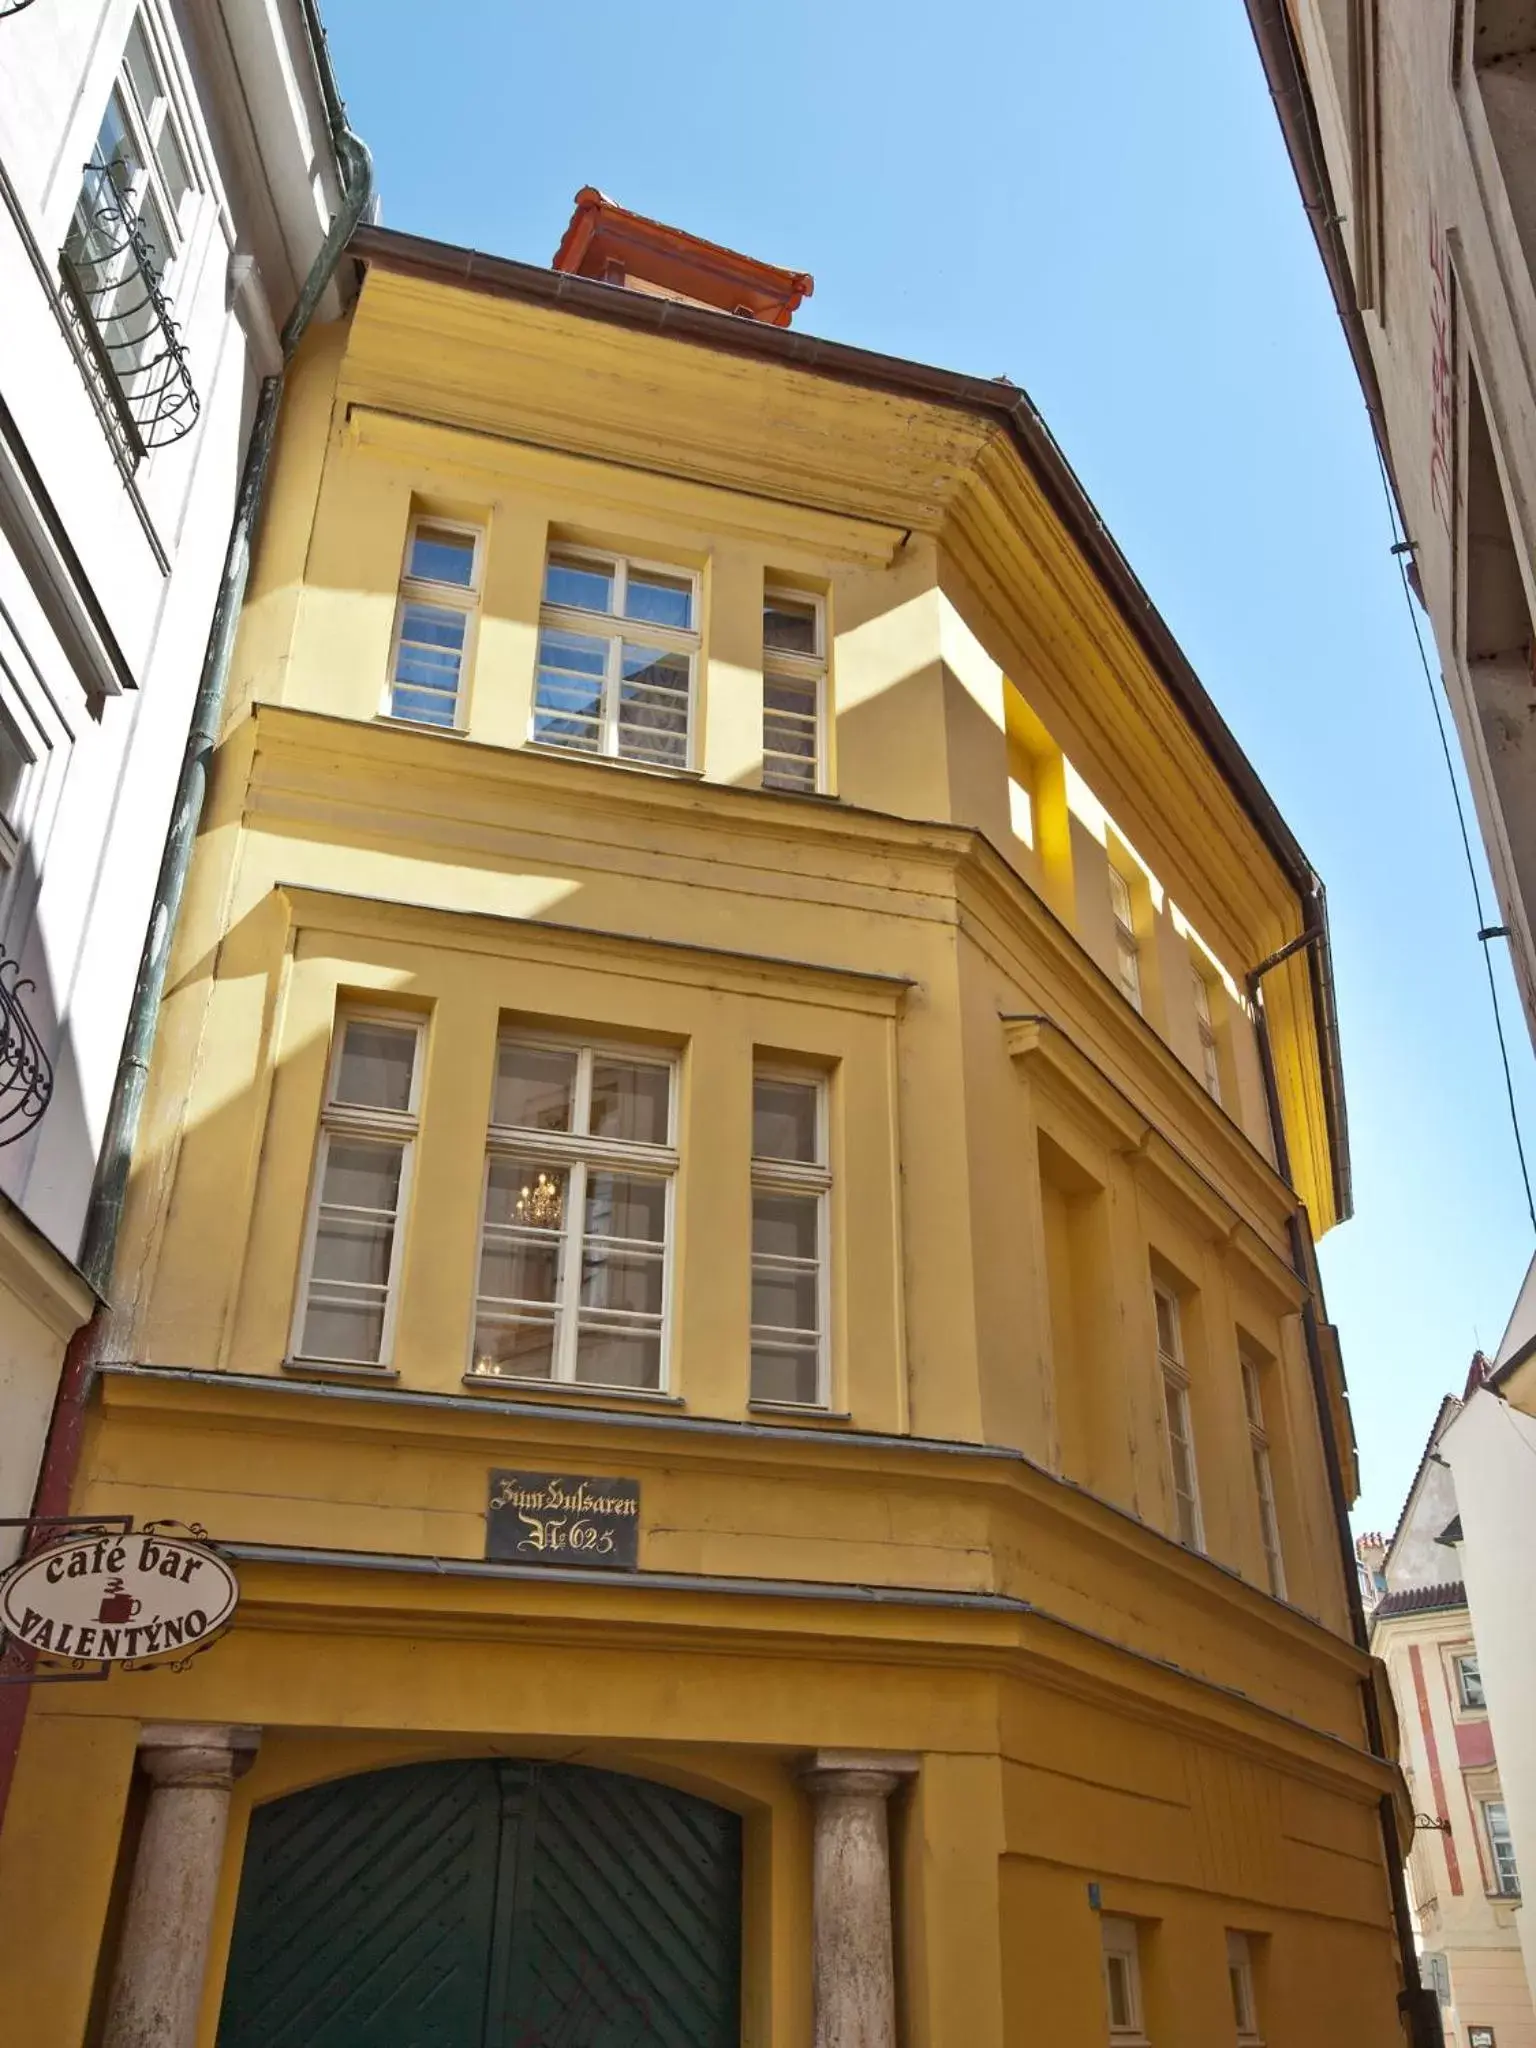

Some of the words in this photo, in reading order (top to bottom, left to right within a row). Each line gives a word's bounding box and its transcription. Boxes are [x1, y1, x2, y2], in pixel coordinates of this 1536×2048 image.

[46, 1537, 127, 1584] café
[138, 1537, 203, 1584] bar
[19, 1607, 208, 1657] VALENTÝNO
